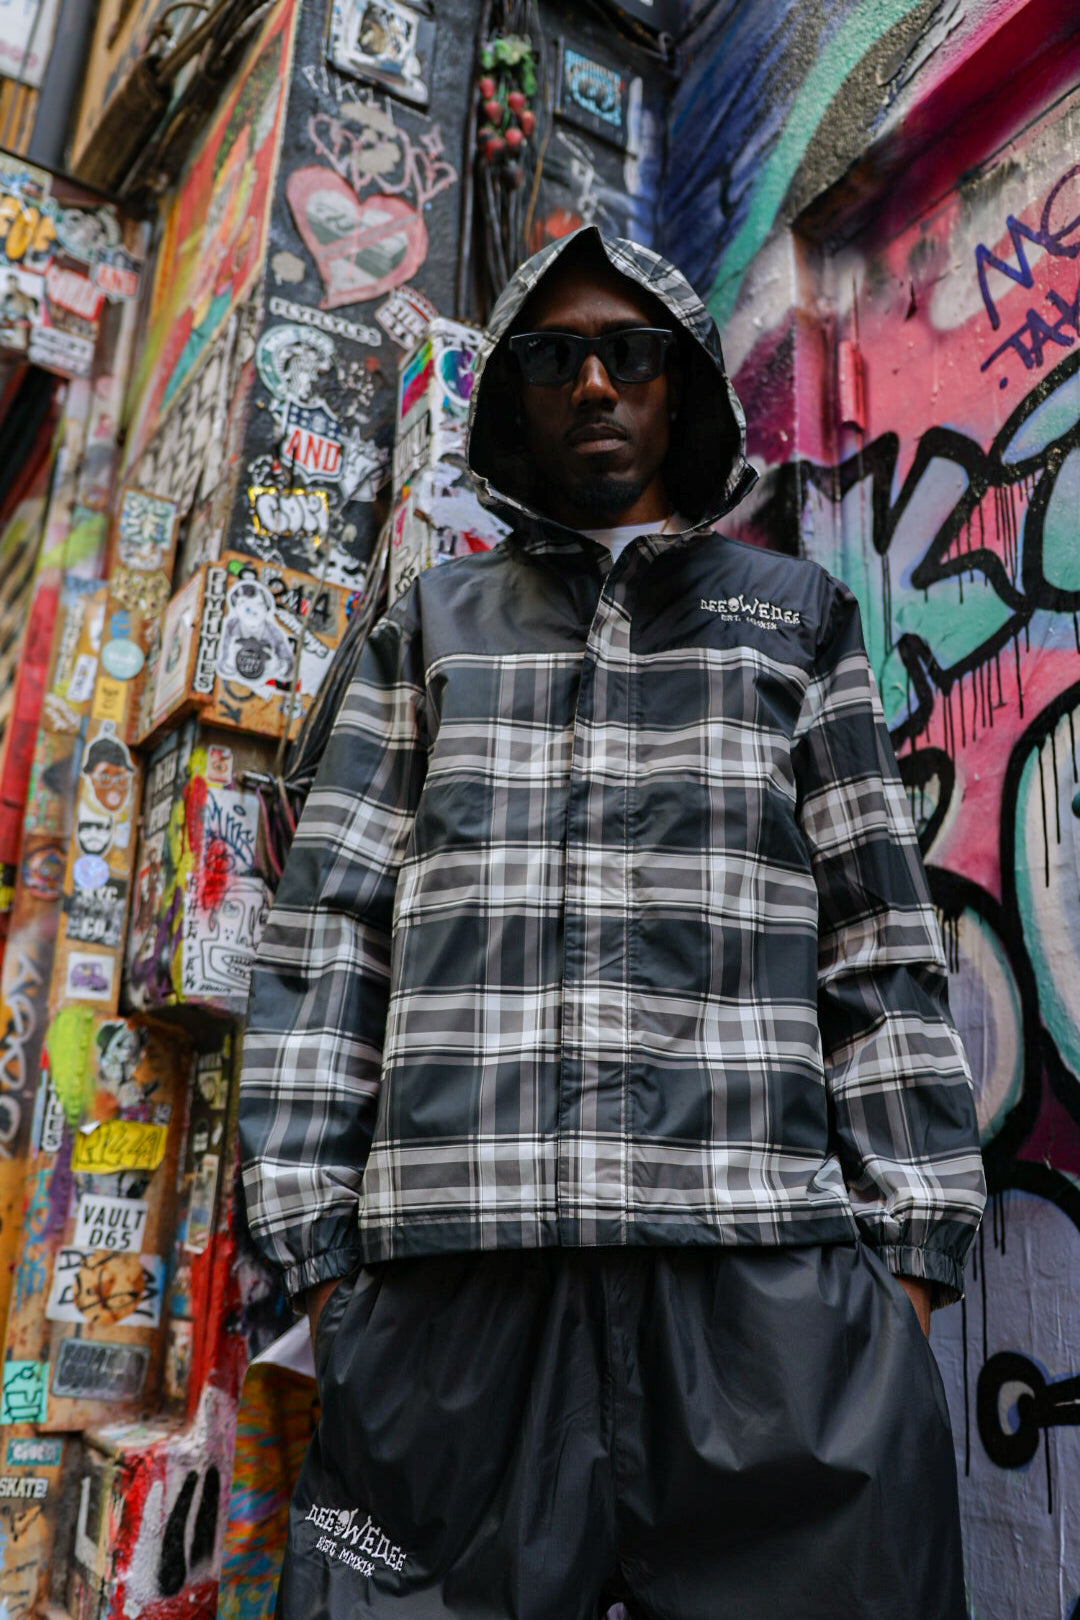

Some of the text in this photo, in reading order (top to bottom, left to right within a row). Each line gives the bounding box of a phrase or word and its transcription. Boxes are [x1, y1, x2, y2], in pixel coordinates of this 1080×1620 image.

[285, 429, 341, 473] AND
[84, 1205, 146, 1230] VAULT
[88, 1229, 133, 1250] D65
[305, 1504, 340, 1532] DEE
